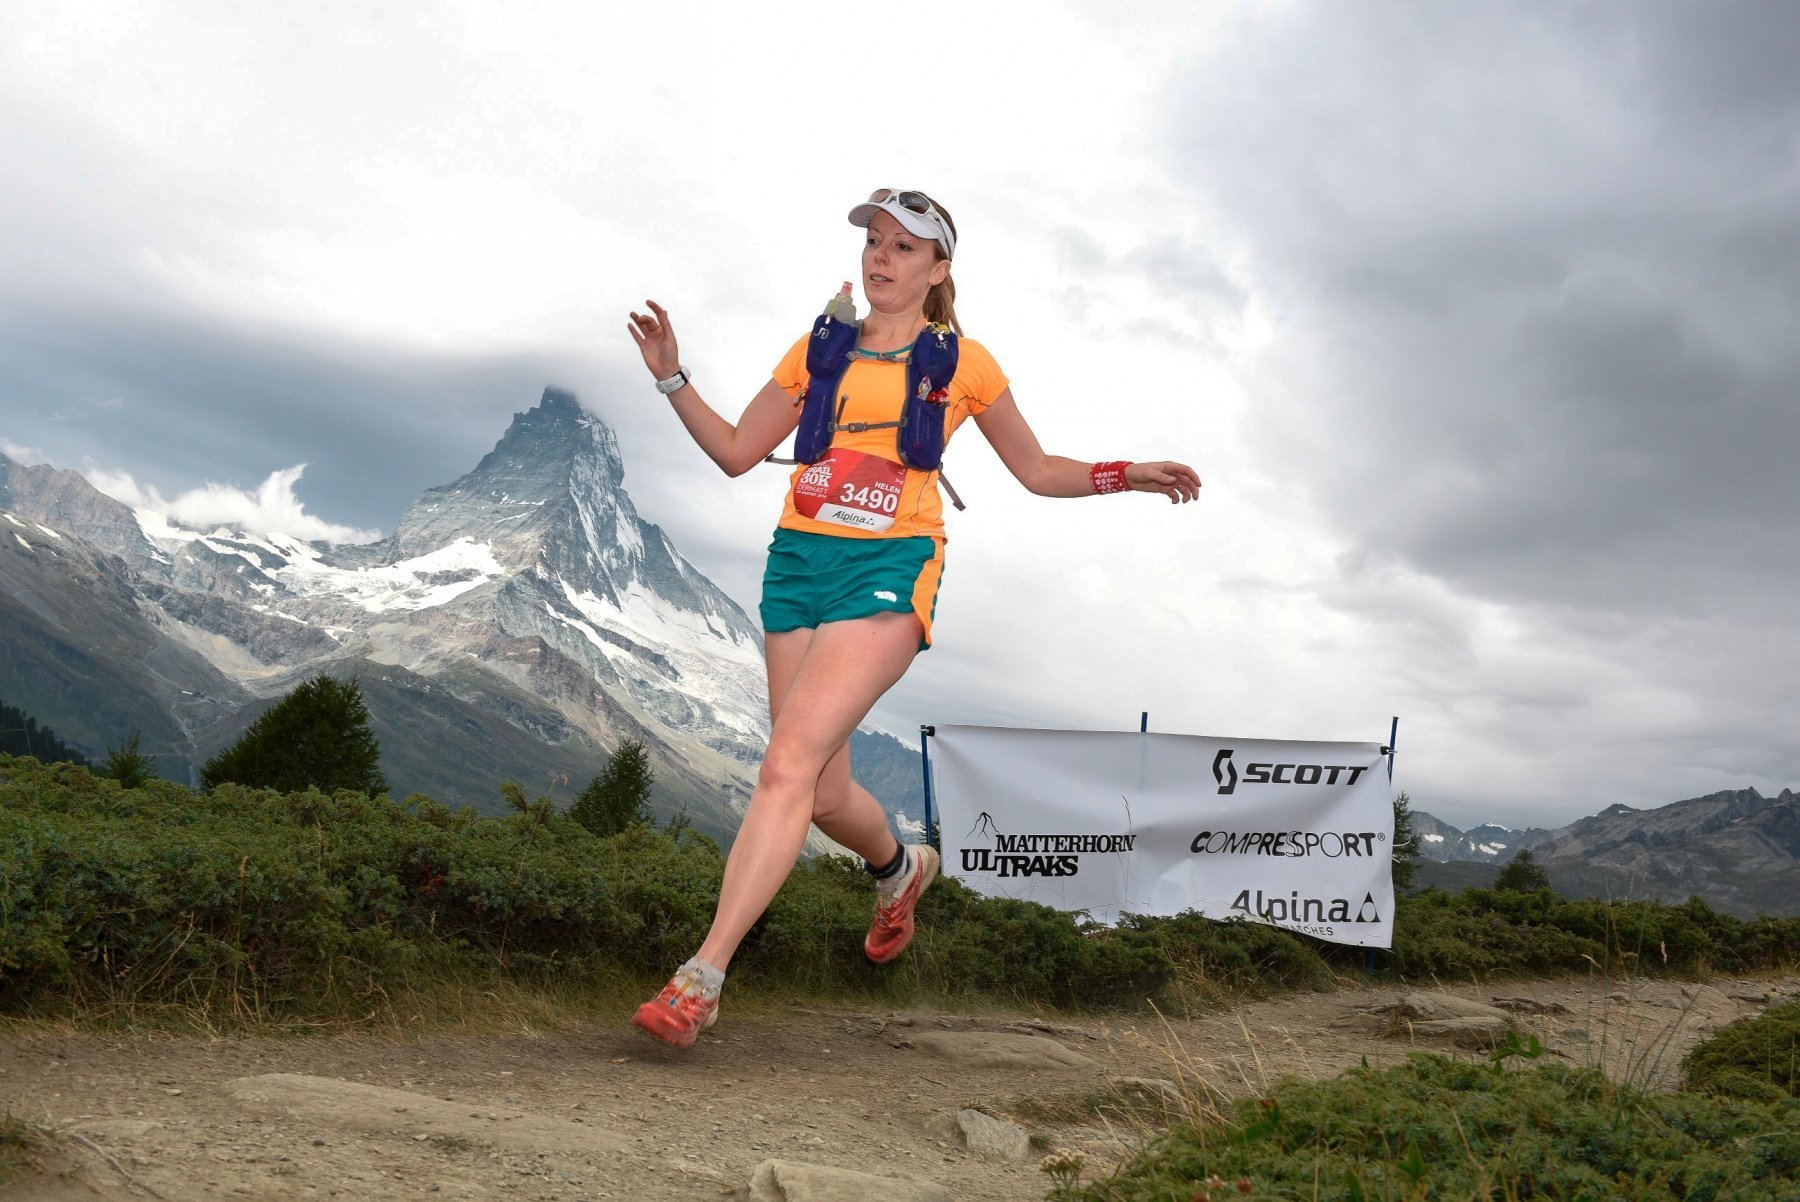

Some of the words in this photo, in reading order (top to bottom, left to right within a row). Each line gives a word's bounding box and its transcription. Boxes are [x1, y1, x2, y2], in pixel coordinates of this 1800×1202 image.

[799, 472, 832, 488] 30K
[874, 481, 901, 494] HELEN
[840, 482, 898, 513] 3490
[832, 510, 866, 524] Alpina
[1242, 762, 1369, 786] SCOTT
[994, 834, 1137, 854] MATTERHORN
[960, 848, 1079, 878] ULTRAKS
[1230, 889, 1352, 925] Alpina
